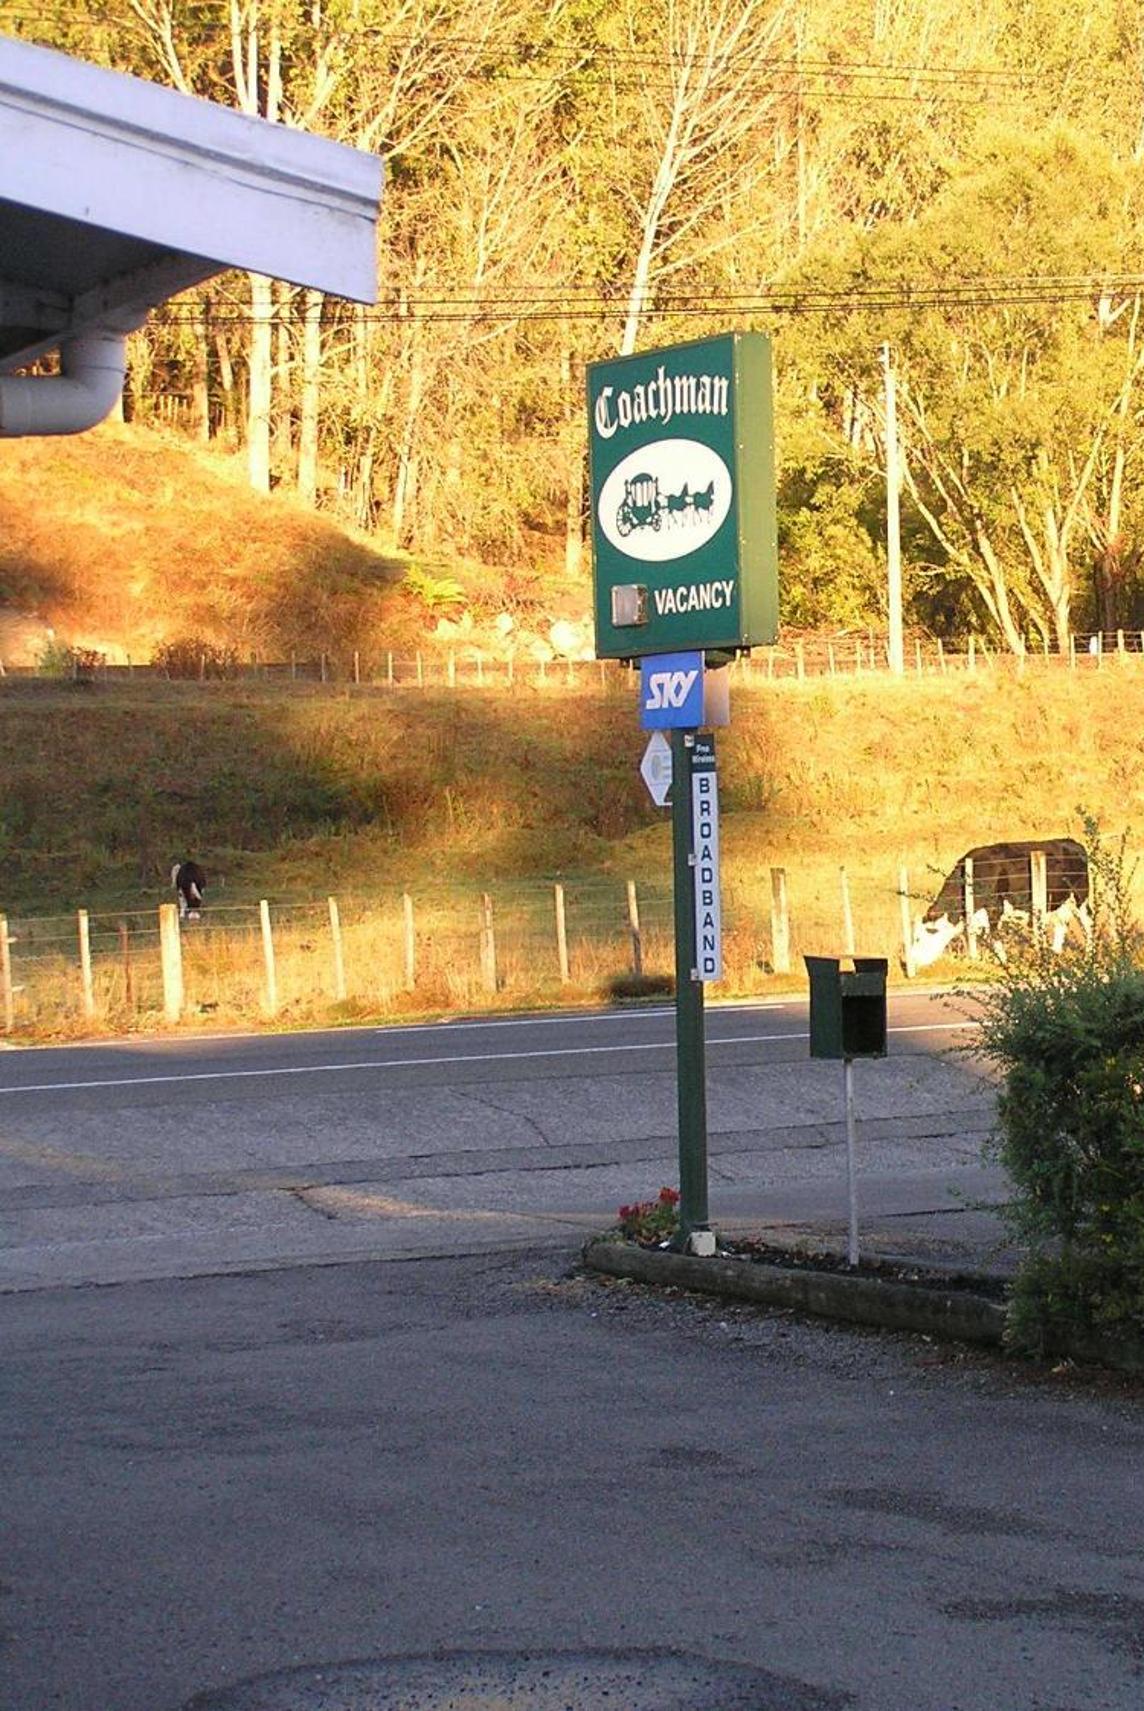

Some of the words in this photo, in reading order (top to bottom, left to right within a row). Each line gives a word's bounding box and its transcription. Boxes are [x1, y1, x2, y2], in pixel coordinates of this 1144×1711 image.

[595, 365, 728, 438] Coachman
[654, 580, 734, 615] VACANCY
[646, 670, 699, 709] SKY
[699, 778, 715, 974] BROADBAND
